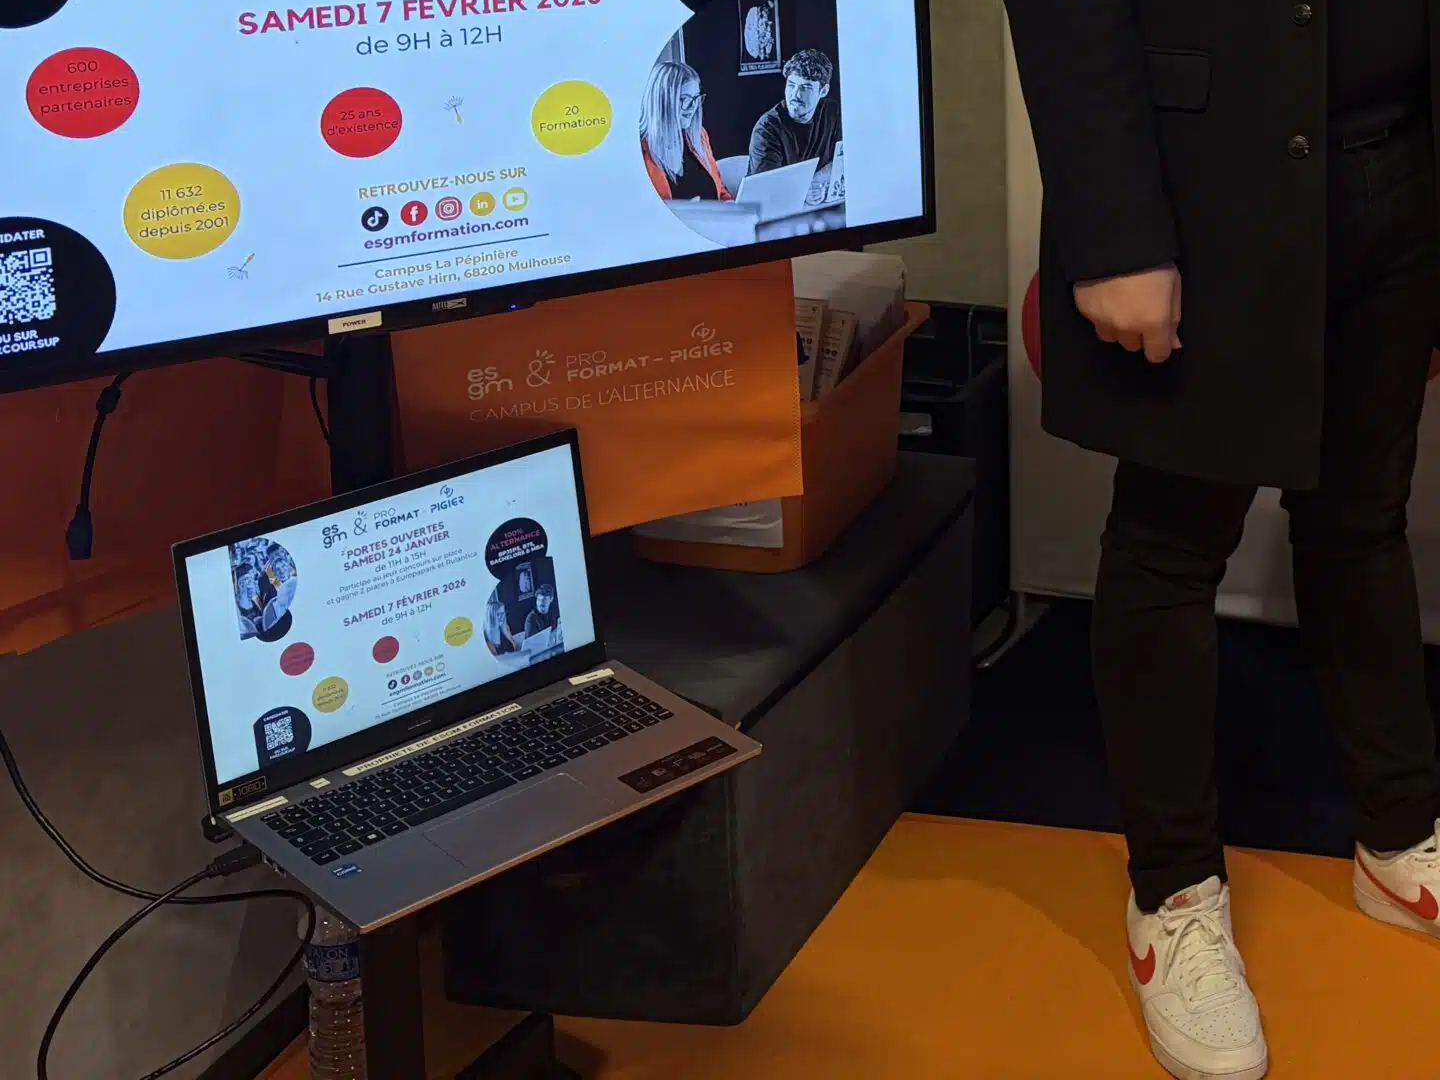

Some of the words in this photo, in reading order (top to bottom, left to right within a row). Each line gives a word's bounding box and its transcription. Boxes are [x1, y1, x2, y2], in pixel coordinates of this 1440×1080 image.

[238, 4, 367, 35] SAMEDI
[376, 1, 393, 23] 7
[356, 36, 389, 56] de
[396, 31, 431, 52] 9H
[440, 27, 453, 48] à
[459, 25, 503, 45] 12H
[67, 60, 99, 74] 600
[38, 76, 130, 95] entreprises
[40, 95, 132, 116] partenaires
[340, 110, 355, 121] 25
[357, 108, 381, 119] ans
[565, 105, 579, 116] 20
[327, 120, 399, 136] d'existence
[539, 115, 606, 132] Formations
[159, 189, 171, 200] 11
[175, 185, 203, 199] 632
[358, 170, 496, 200] RETROUVEZ-NOUS
[499, 167, 527, 180] SUR
[141, 201, 226, 221] diplômé.es
[139, 221, 192, 239] depuis
[195, 217, 229, 232] 2001
[364, 217, 529, 250] esgmformation.com
[375, 261, 432, 281] Campus
[436, 259, 452, 270] La
[455, 247, 519, 268] Pépinière
[316, 291, 332, 303] 14
[336, 286, 365, 301] Rue
[368, 276, 425, 295] Gustave
[428, 271, 461, 285] Hirn,
[464, 263, 505, 279] 68200
[508, 252, 571, 272] Mulhouse
[566, 350, 607, 368] PRO
[567, 356, 649, 382] FORMAT
[670, 341, 734, 363] PIGIER
[469, 396, 559, 422] CAMPUS
[565, 394, 593, 411] DE
[375, 509, 420, 530] FORMAT
[343, 550, 386, 571] SAMEDI
[388, 545, 401, 557] 24
[404, 530, 450, 552] JANVIER
[346, 539, 388, 560] PORTES
[390, 521, 445, 545] OUVERTES
[343, 605, 386, 627] SAMEDI
[443, 578, 467, 593] 2026
